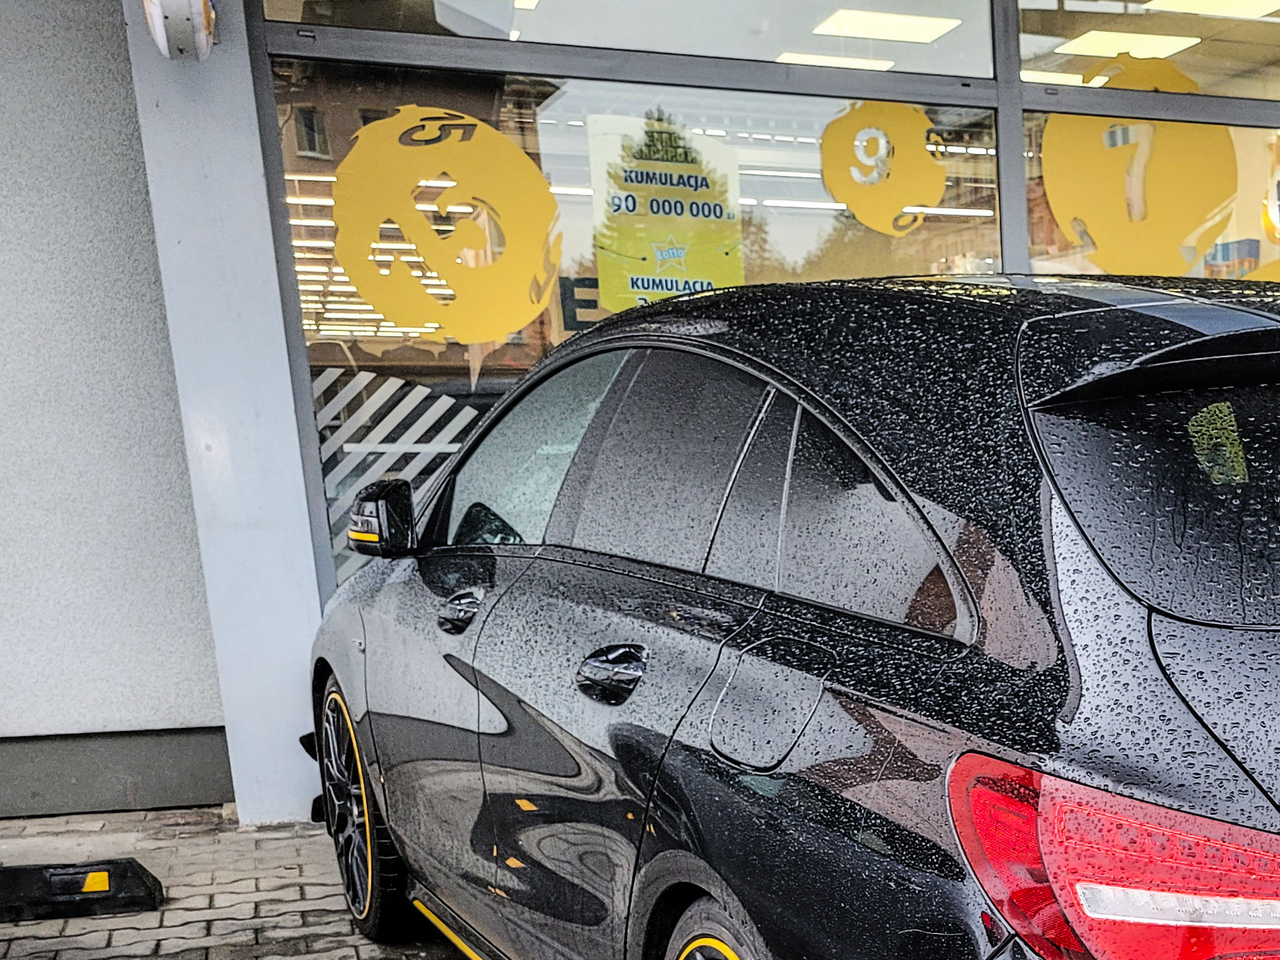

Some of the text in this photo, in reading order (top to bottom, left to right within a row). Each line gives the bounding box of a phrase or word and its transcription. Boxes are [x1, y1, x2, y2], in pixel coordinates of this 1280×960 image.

[850, 127, 893, 185] 9
[1102, 123, 1156, 222] 7
[623, 170, 710, 191] KUMULACJA
[611, 194, 637, 213] 90
[650, 198, 684, 216] 000
[689, 202, 724, 219] 000
